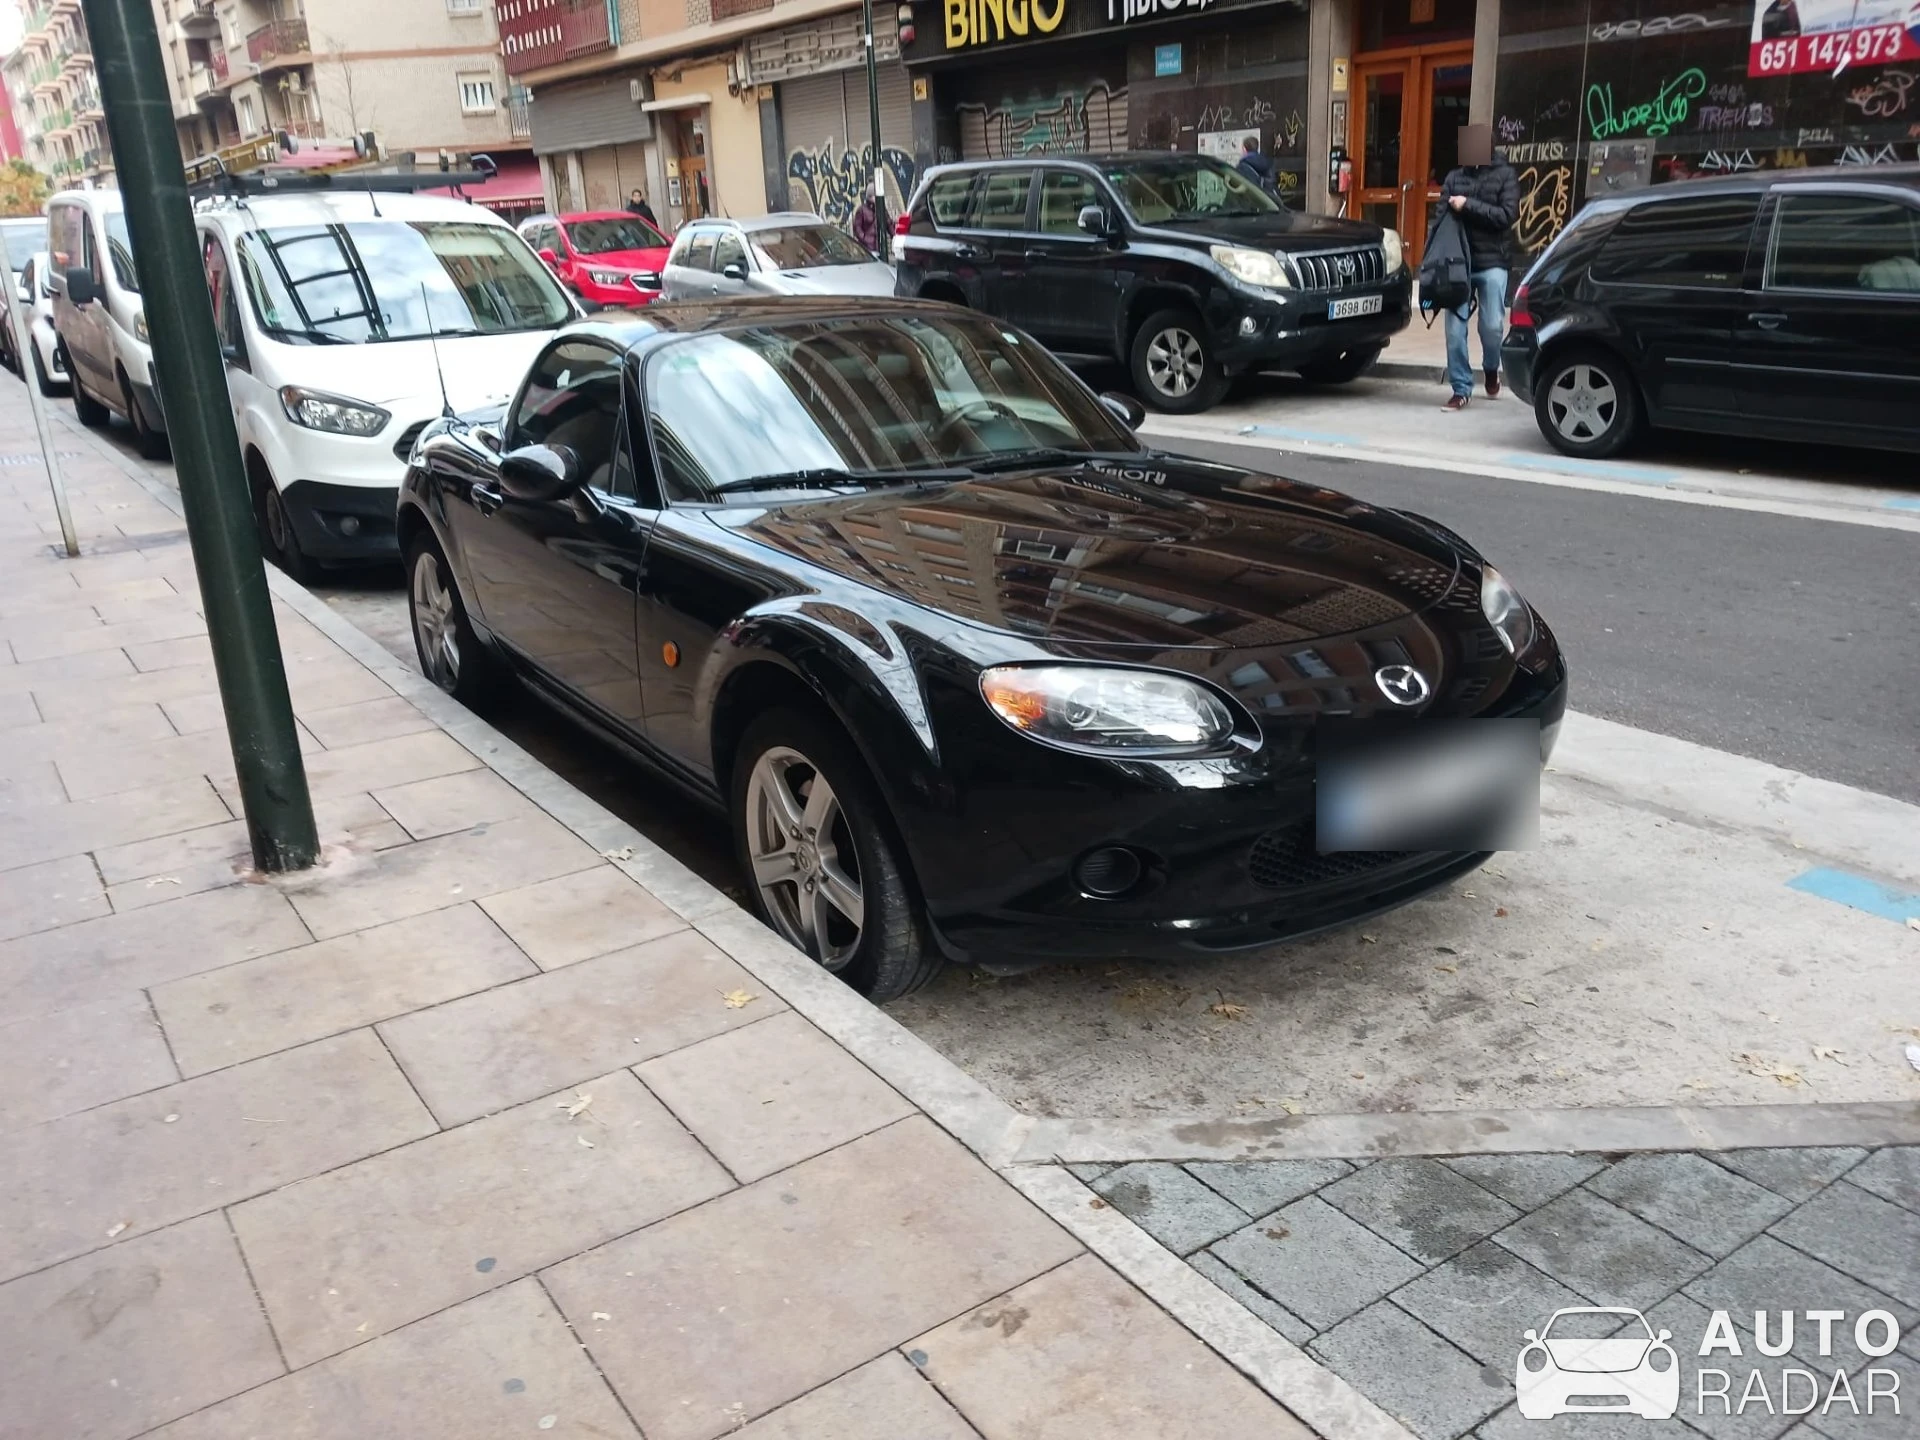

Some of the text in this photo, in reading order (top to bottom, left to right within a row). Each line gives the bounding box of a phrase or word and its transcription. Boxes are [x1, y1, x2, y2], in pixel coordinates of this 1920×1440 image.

[945, 0, 1065, 48] BINGO
[1760, 26, 1901, 71] 651 147 973
[1336, 301, 1359, 316] 3698
